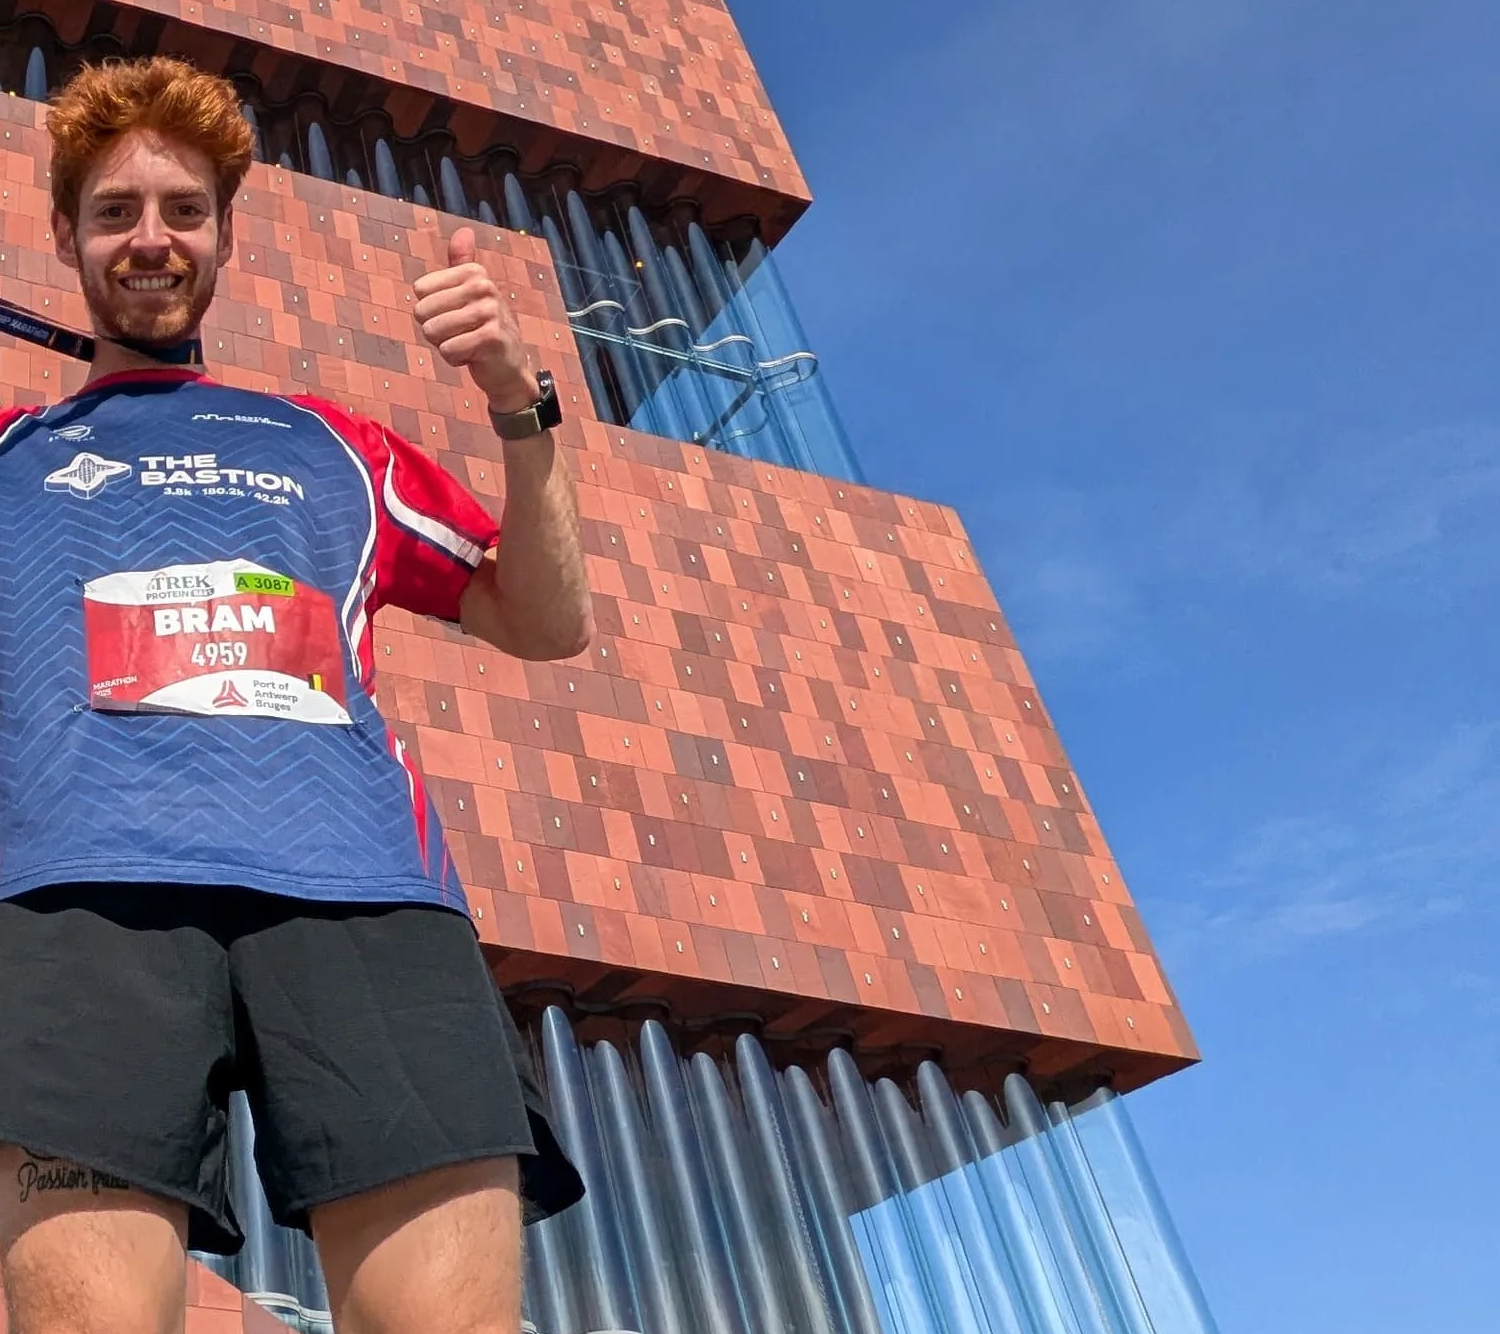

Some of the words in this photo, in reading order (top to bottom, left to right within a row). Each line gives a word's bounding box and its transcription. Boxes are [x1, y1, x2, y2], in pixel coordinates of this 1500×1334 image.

[139, 453, 217, 469] THE
[140, 469, 305, 500] BASTION
[163, 487, 192, 496] 3.8k
[253, 492, 290, 505] 42.2k
[150, 575, 214, 591] TREK
[236, 577, 249, 588] A
[254, 577, 290, 591] 3087
[146, 590, 189, 601] PROTEIN
[153, 605, 275, 636] BRAM
[191, 642, 247, 666] 4959
[93, 674, 137, 690] MARATHON
[253, 680, 276, 689] Port
[278, 683, 289, 691] of
[255, 690, 298, 703] Antwerp
[256, 699, 291, 711] Bruges
[18, 1162, 87, 1203] Passion
